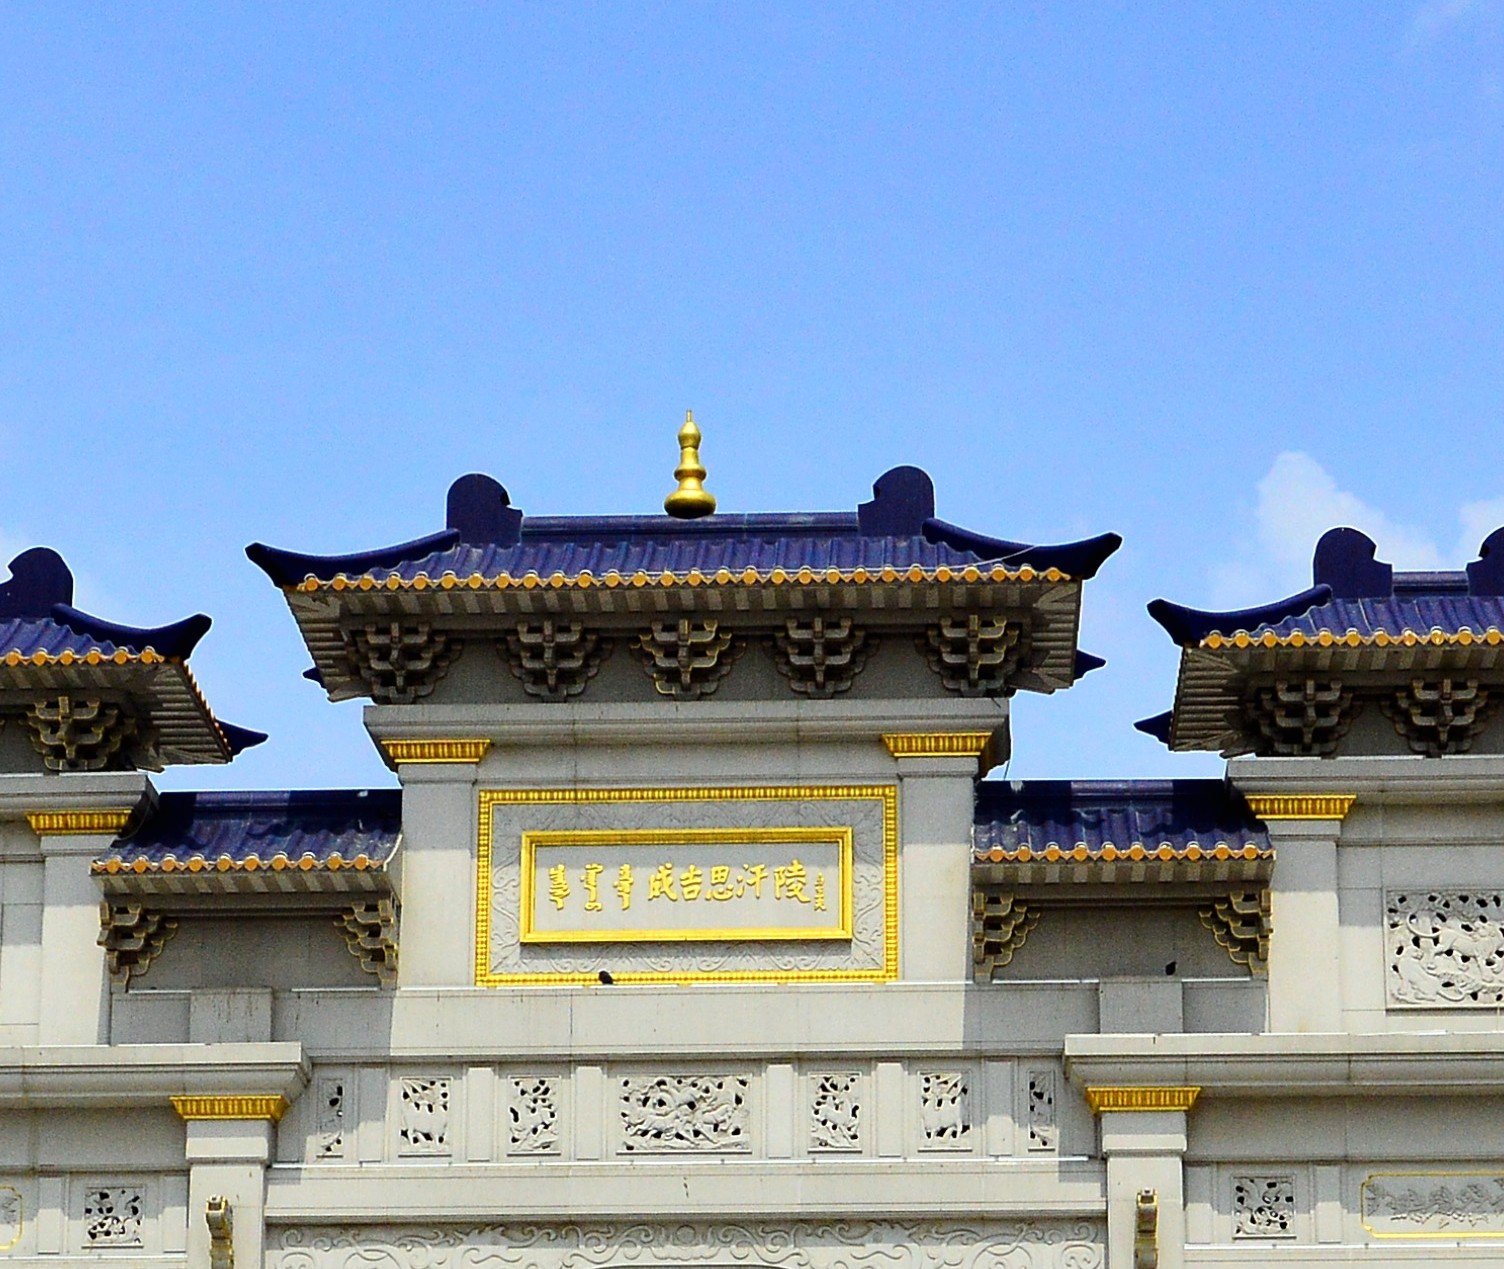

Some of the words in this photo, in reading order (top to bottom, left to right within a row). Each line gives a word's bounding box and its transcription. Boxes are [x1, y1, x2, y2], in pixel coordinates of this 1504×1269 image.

[648, 859, 810, 903] 成吉思汗陵
